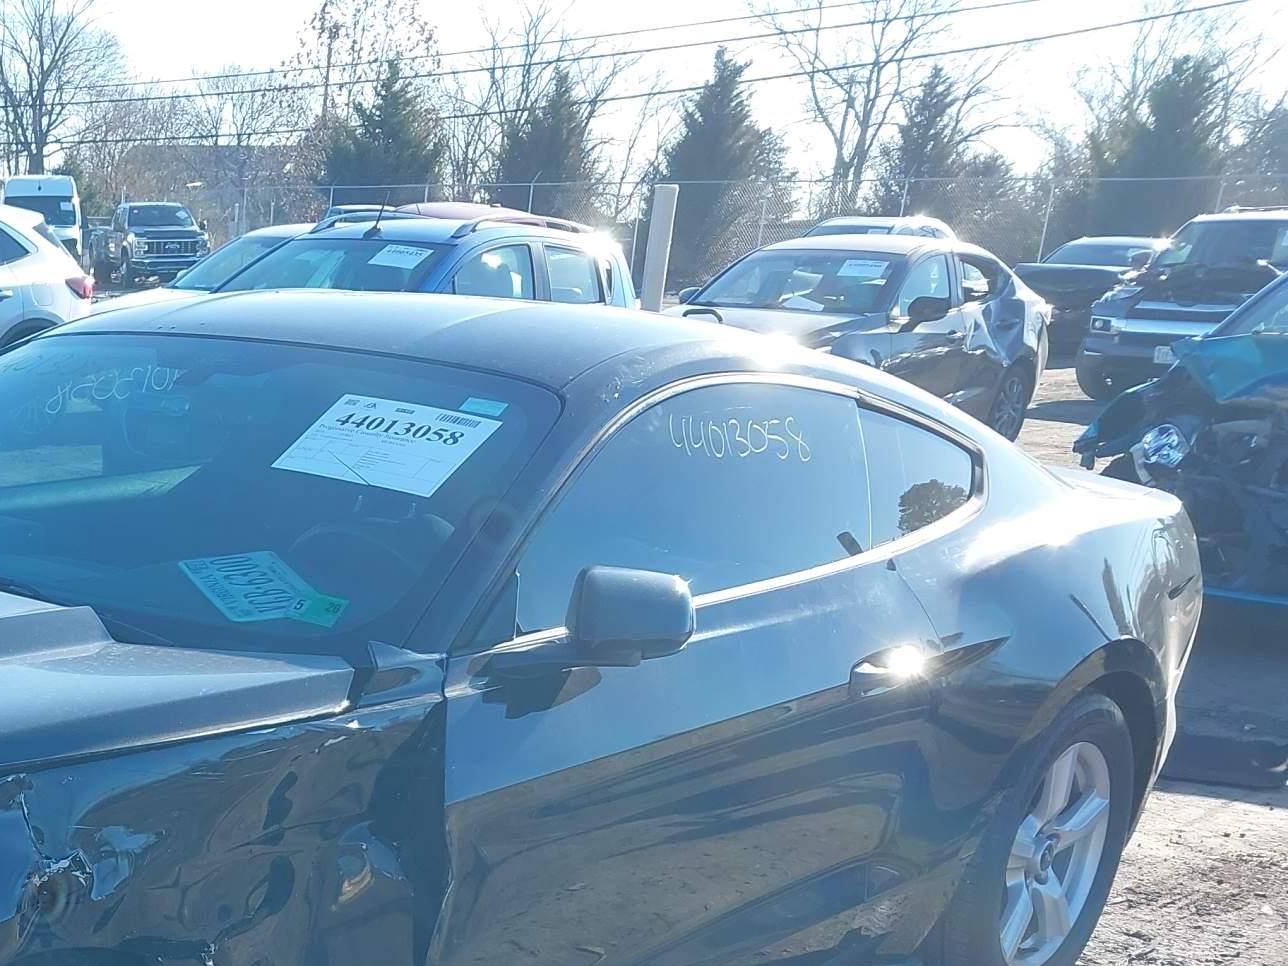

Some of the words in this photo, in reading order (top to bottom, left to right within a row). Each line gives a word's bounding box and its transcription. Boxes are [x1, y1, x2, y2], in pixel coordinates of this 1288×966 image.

[335, 412, 465, 446] 44013058
[670, 413, 811, 462] 44013058
[293, 598, 307, 611] 5
